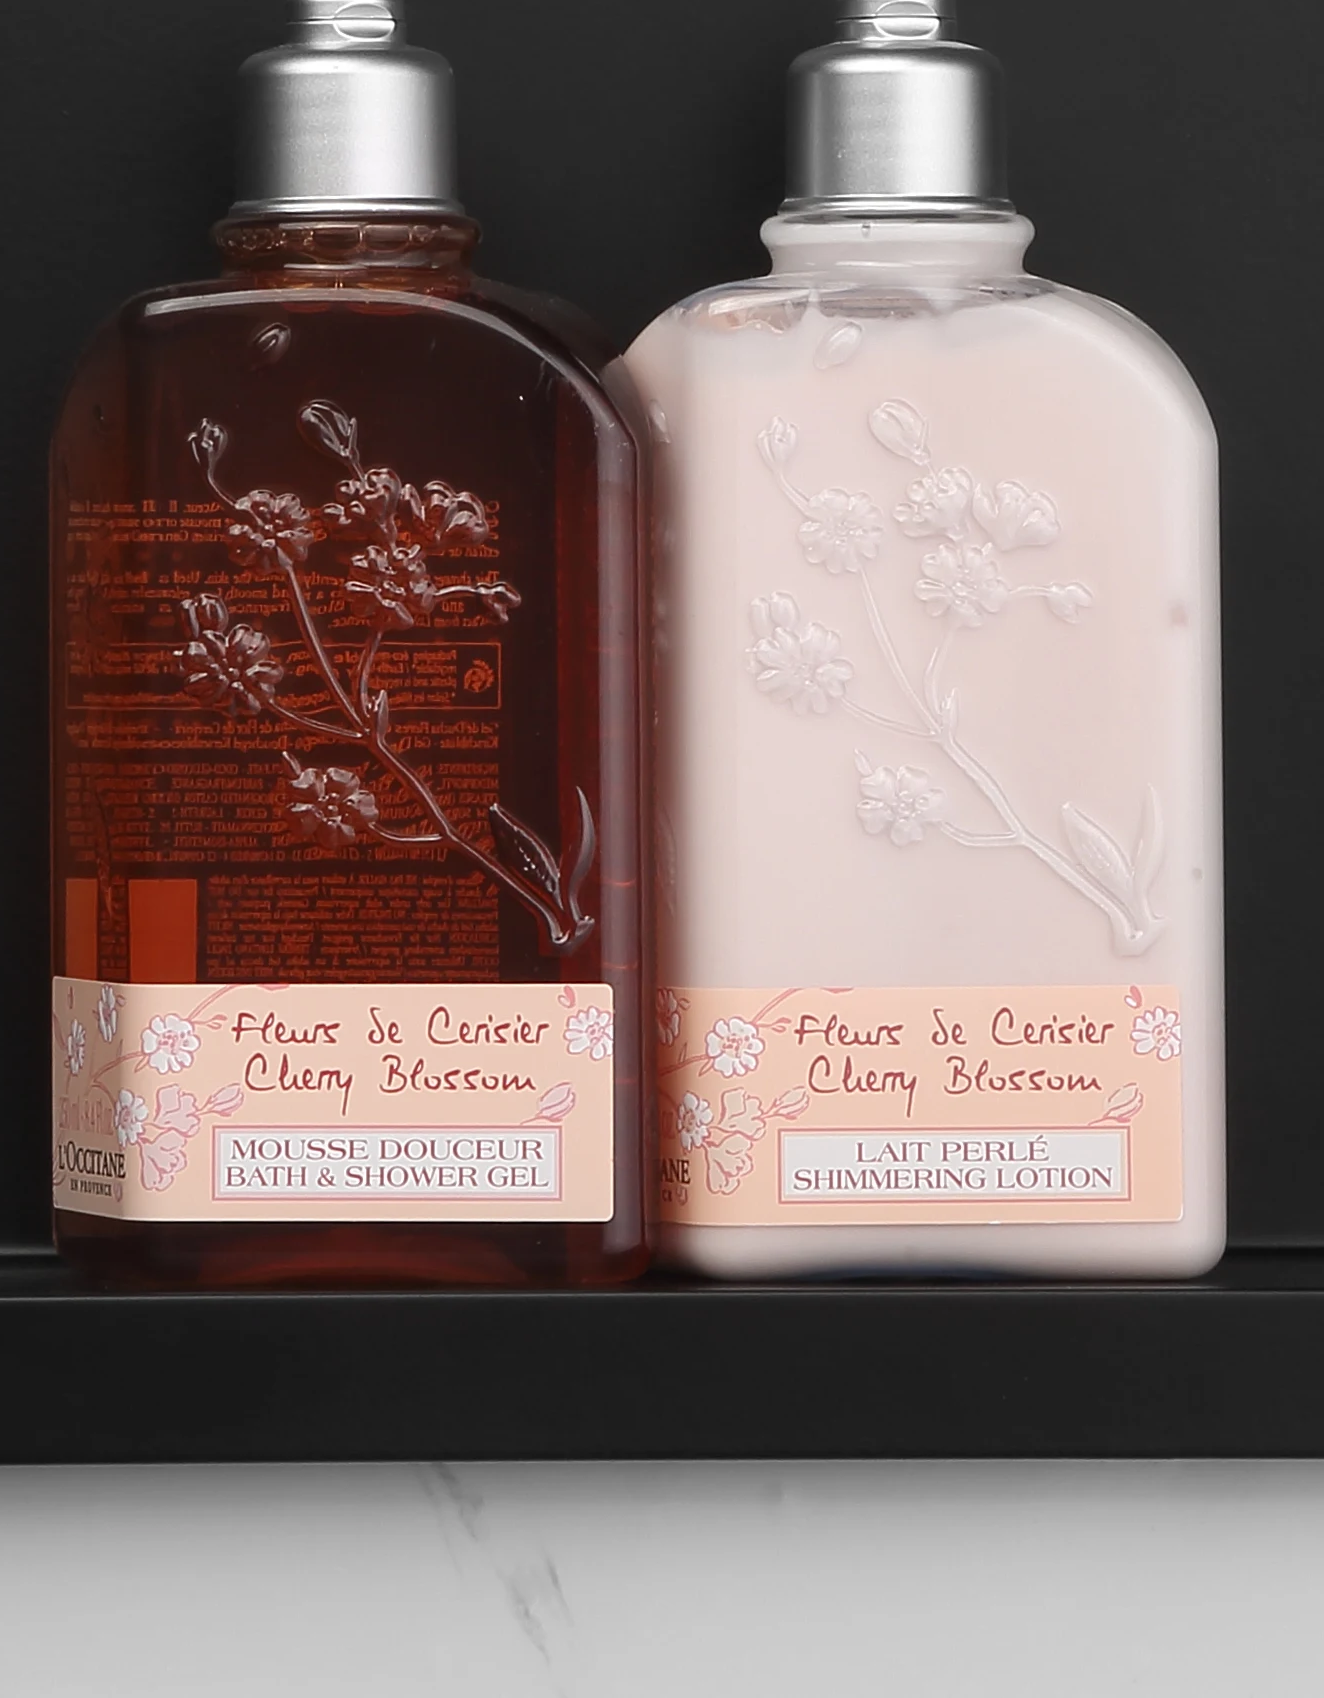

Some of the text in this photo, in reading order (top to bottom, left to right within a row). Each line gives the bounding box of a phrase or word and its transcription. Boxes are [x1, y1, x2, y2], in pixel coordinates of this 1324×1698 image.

[230, 1005, 551, 1045] Fleurs de Cerisier
[793, 1006, 1115, 1046] Fleurs de Cerisier
[244, 1052, 537, 1116] Cherry Blossom
[807, 1054, 1102, 1118] Cherry Blossom
[230, 1138, 543, 1161] MOUSSE DOUCEUR
[855, 1135, 1049, 1163] LAIT PERLÉ
[225, 1164, 550, 1188] BATH & SHOWER GEL
[793, 1167, 1112, 1191] SHIMMERING LOTION
